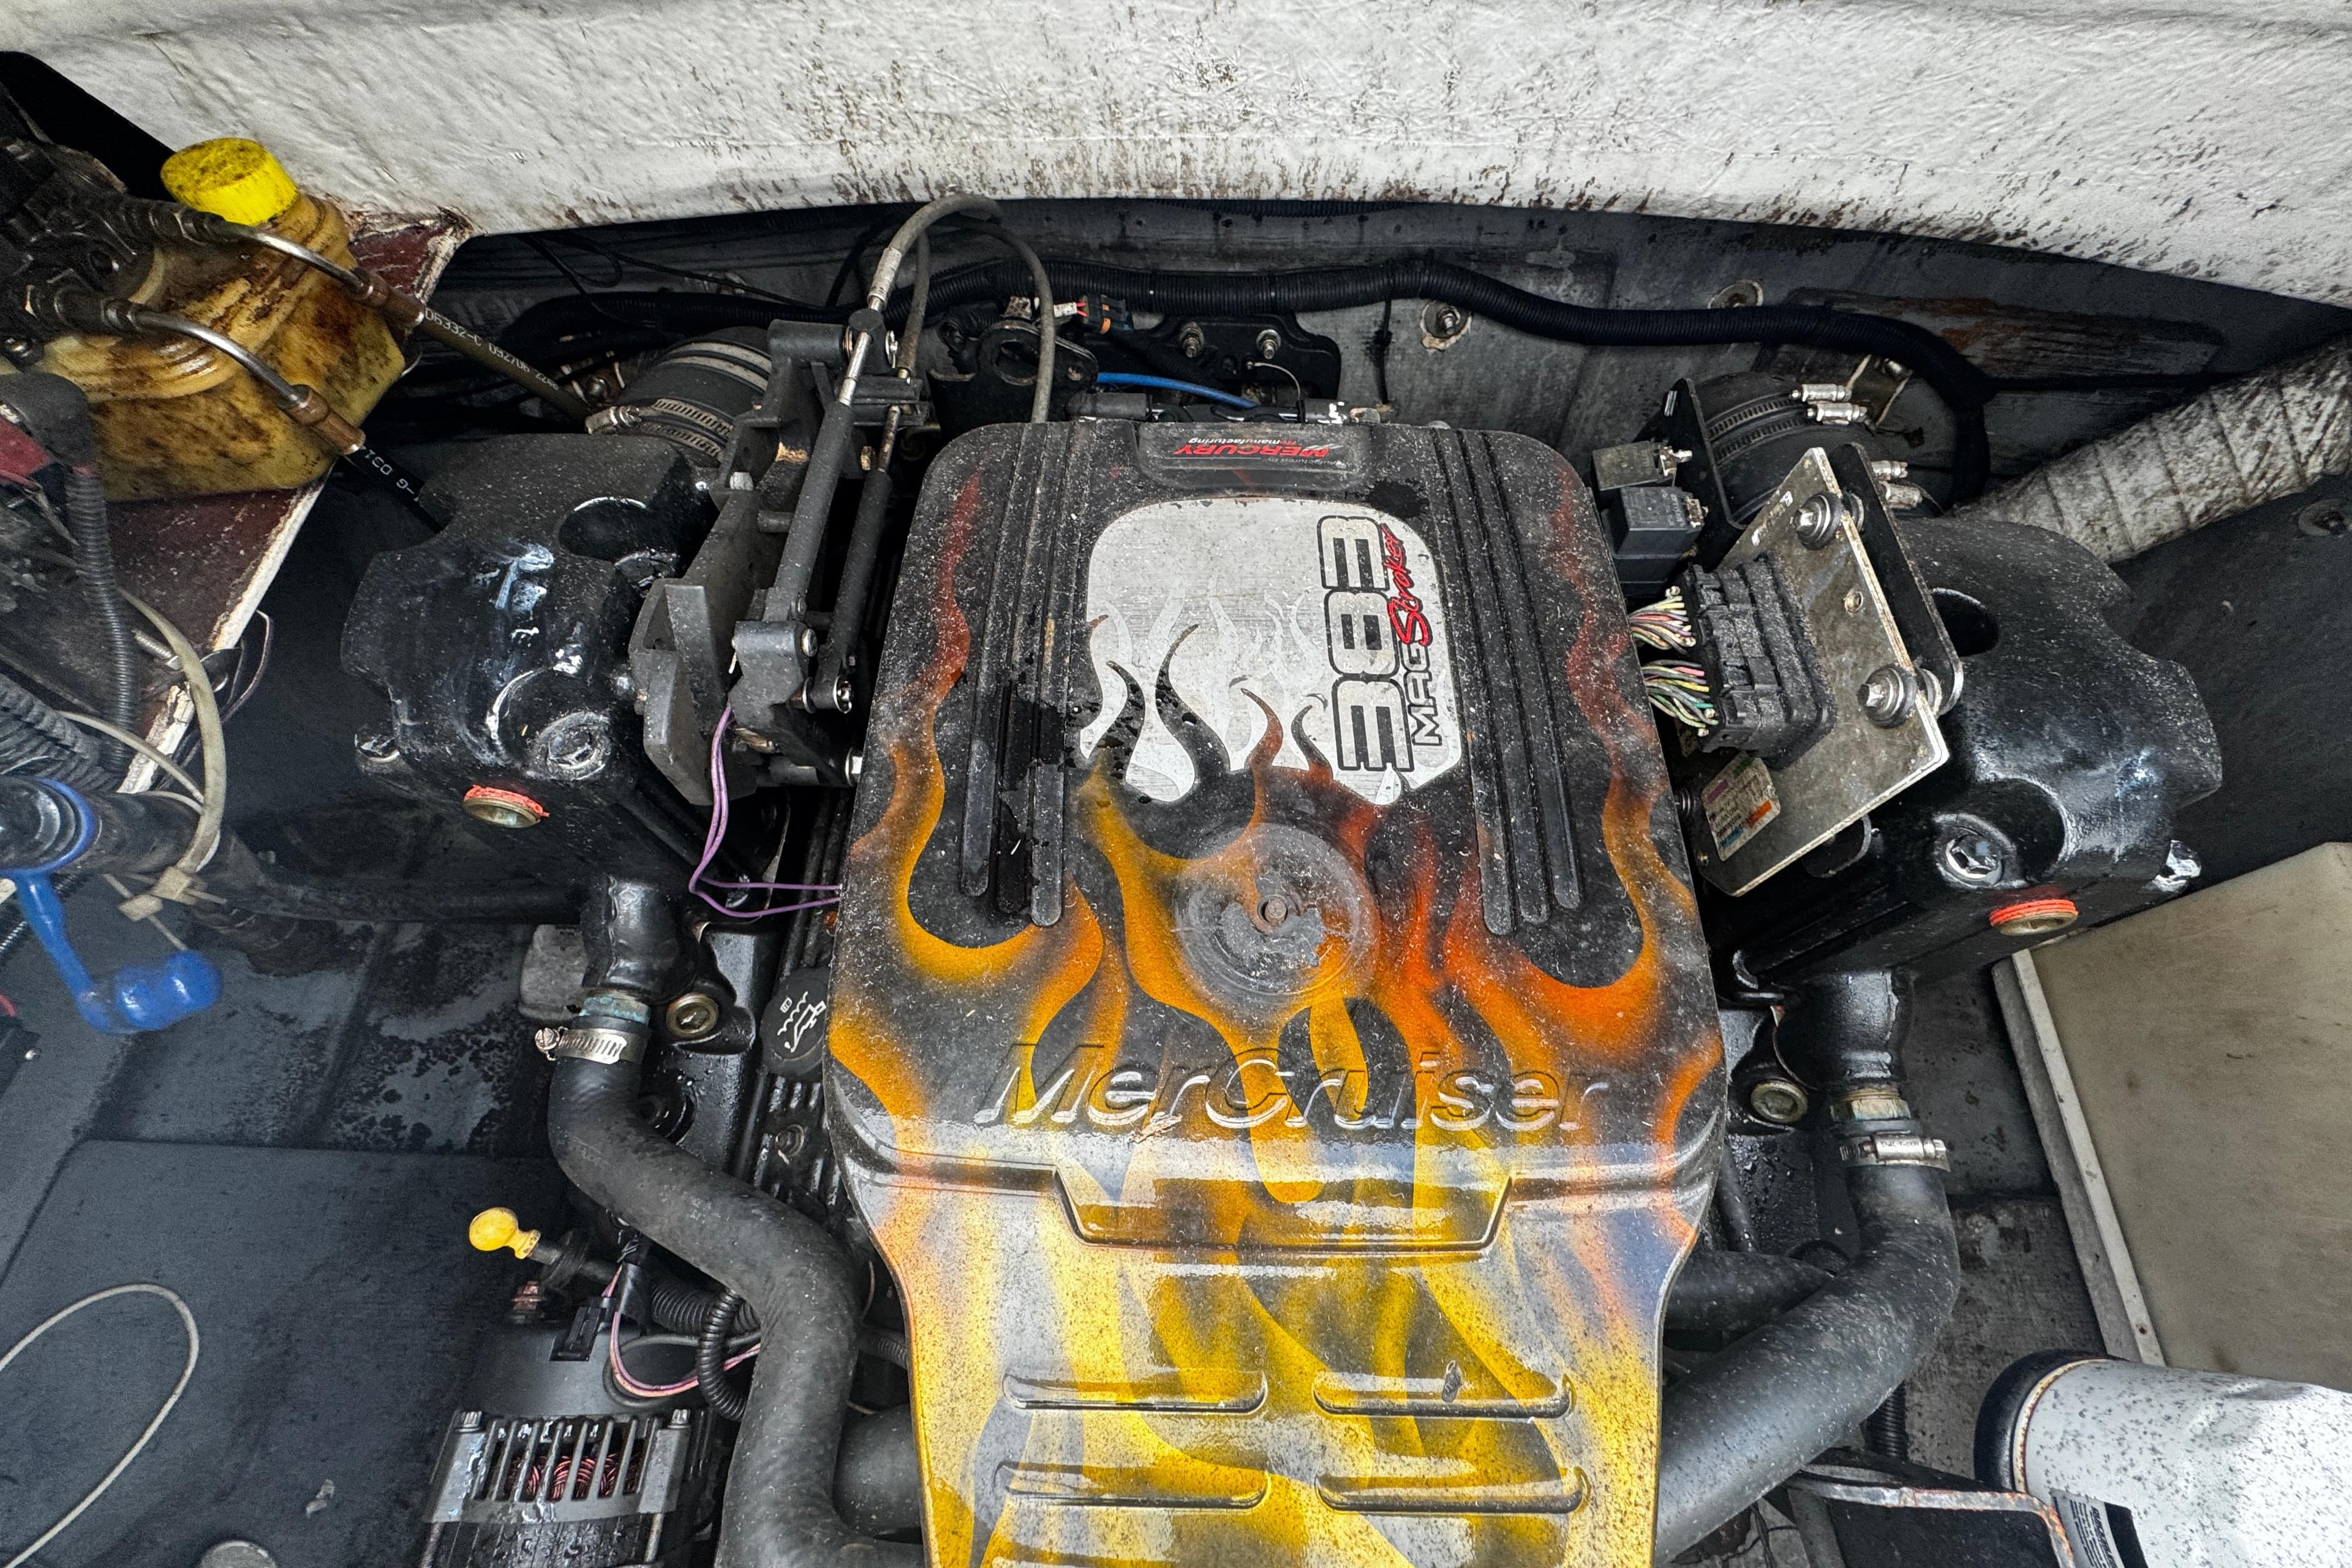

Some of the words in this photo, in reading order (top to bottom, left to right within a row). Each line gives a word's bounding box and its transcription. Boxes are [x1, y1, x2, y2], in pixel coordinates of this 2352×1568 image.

[1172, 443, 1330, 458] MERCURY
[1380, 522, 1434, 647] Stroker
[1317, 515, 1415, 772] 383
[1399, 641, 1443, 746] MAG
[973, 1042, 1609, 1132] MerCruiser
